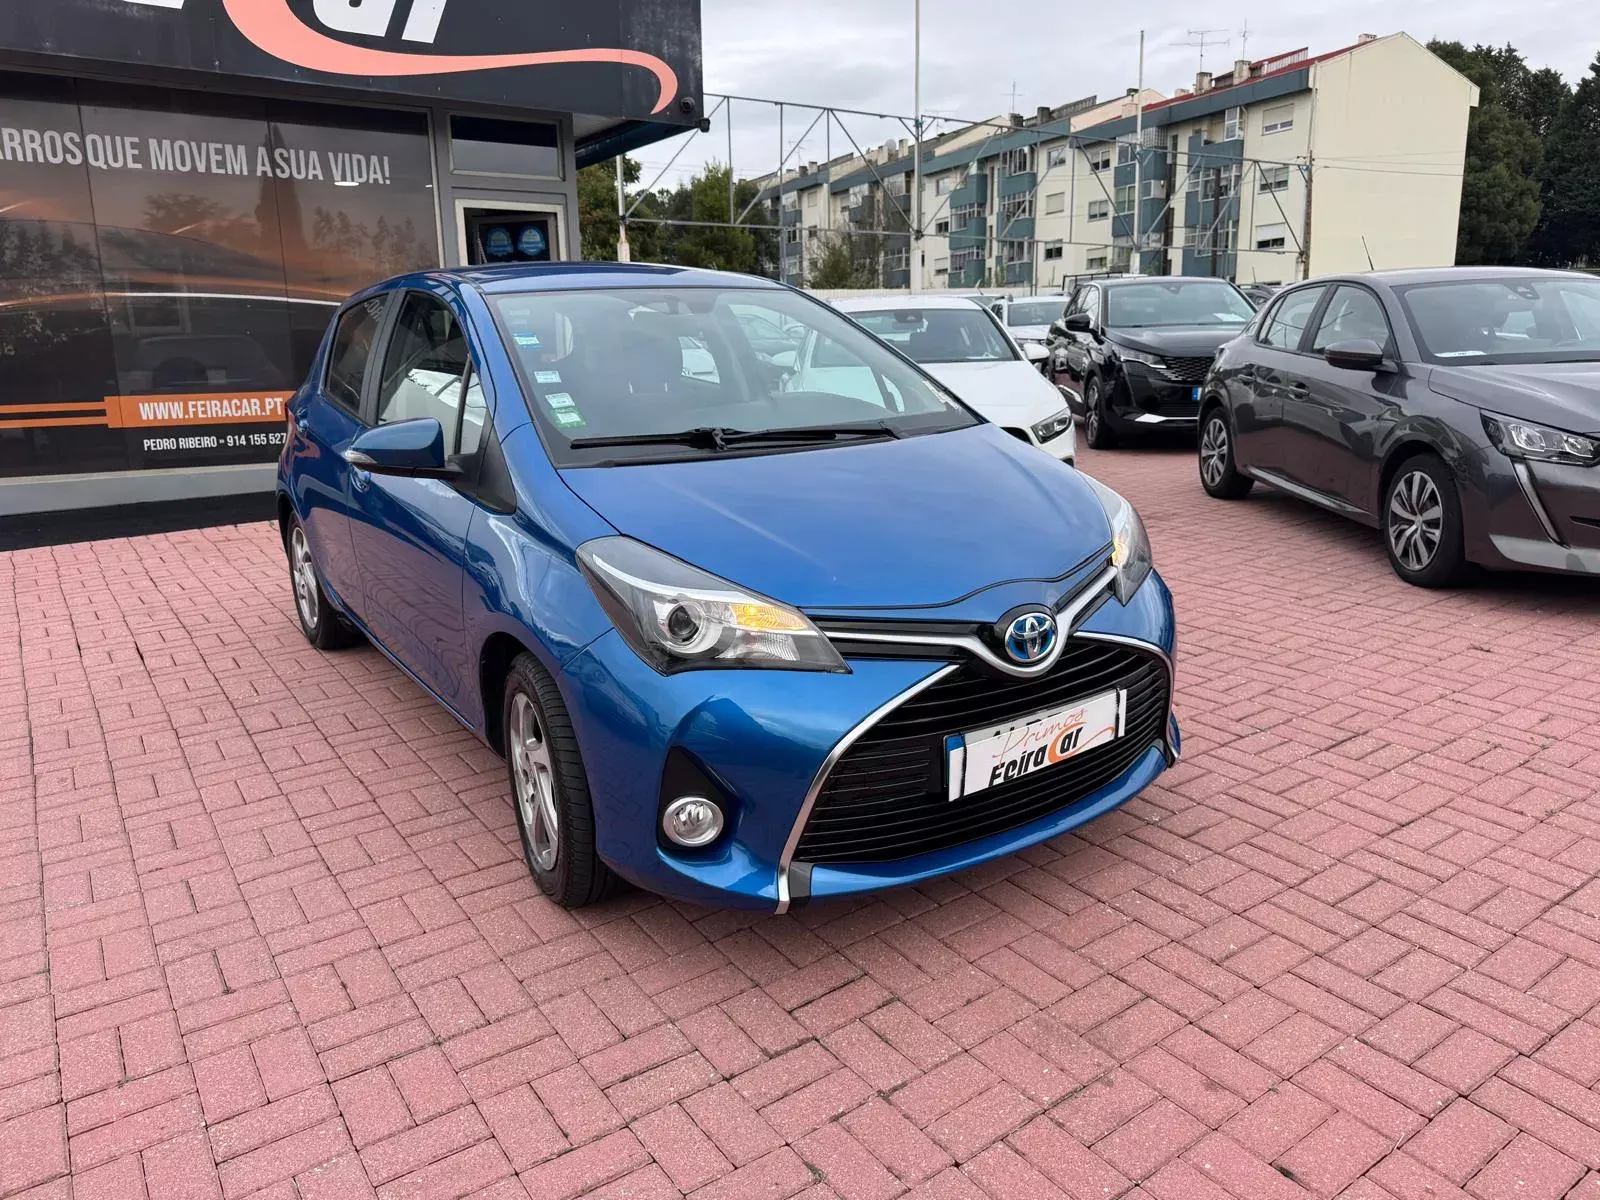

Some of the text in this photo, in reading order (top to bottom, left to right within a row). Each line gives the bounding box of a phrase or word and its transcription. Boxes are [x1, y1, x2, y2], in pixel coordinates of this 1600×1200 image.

[0, 127, 391, 185] RROS QUE MOVEM A SUA VIDA!
[139, 397, 283, 420] WWW.FEIRACAR.PT
[143, 437, 177, 451] PEDRO
[179, 436, 217, 450] RIBEIRO
[226, 434, 247, 447] 914
[249, 433, 267, 446] 155
[269, 432, 287, 445] 527
